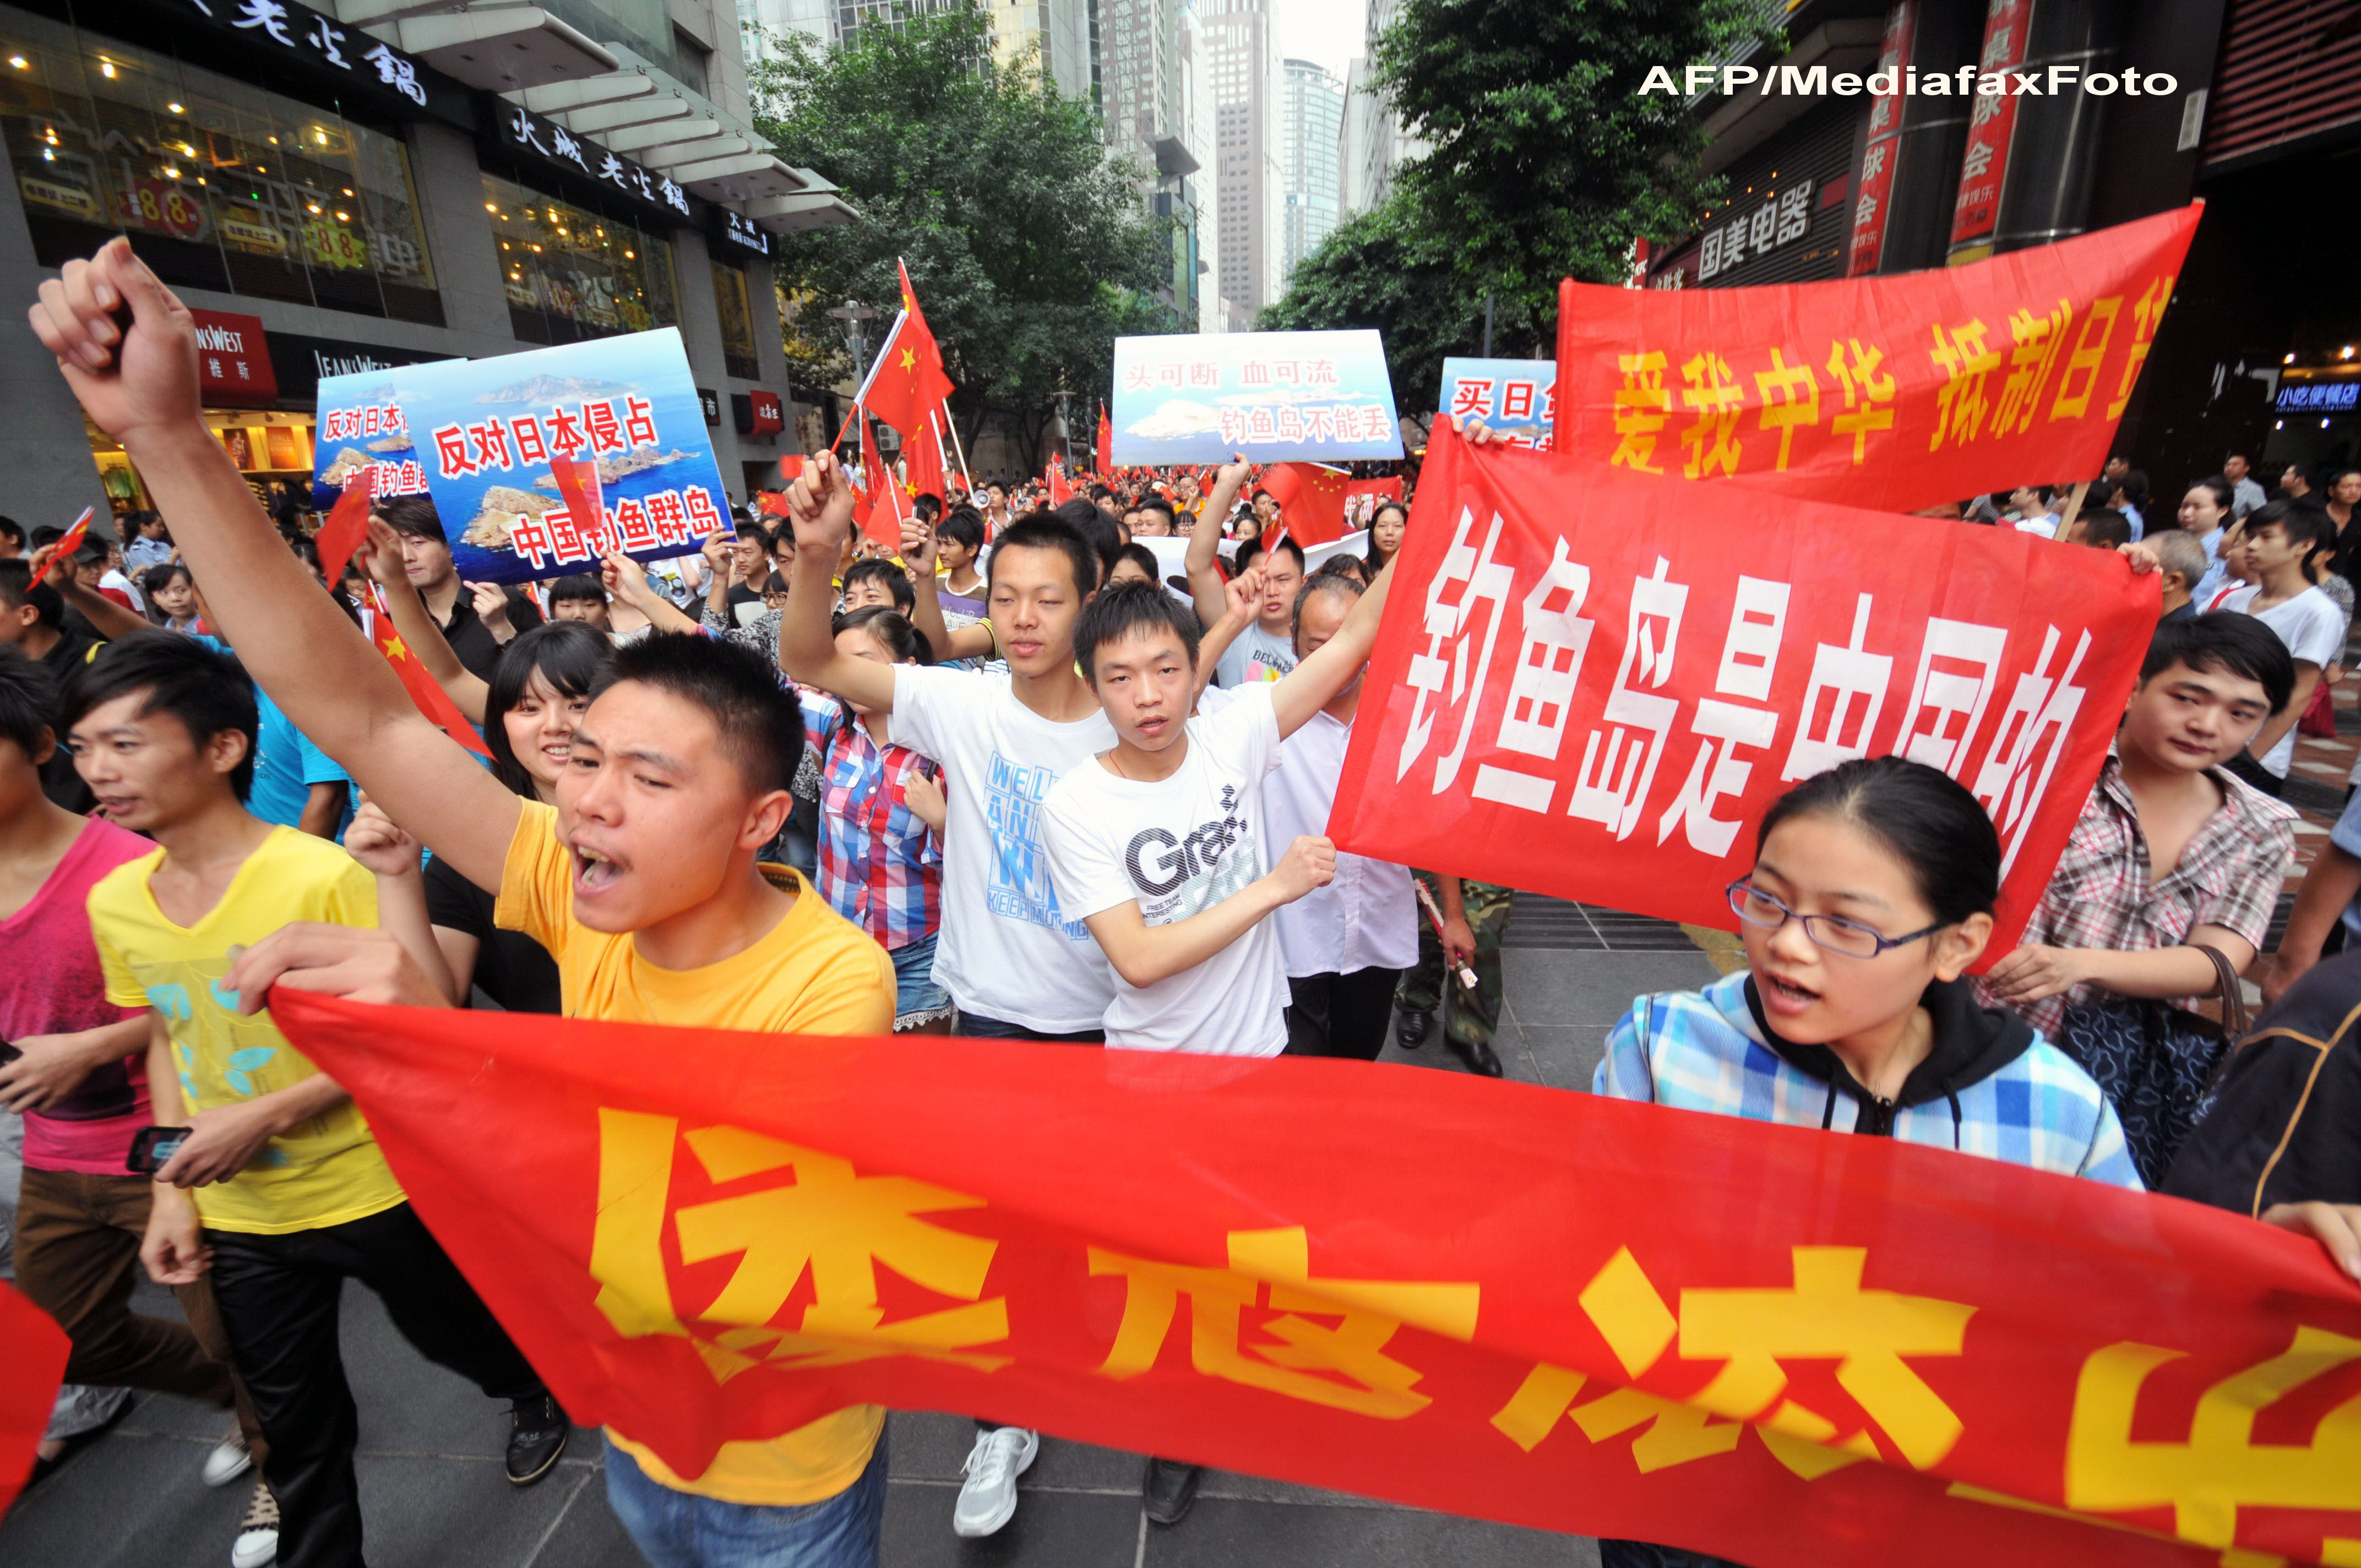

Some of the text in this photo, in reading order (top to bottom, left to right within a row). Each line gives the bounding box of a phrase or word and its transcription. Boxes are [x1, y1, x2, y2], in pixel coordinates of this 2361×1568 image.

[1698, 178, 1812, 281] 国美电器
[1124, 359, 1338, 389] 头可断 血可流
[433, 393, 659, 478] 反对日本侵占
[1219, 406, 1390, 443] 钓鱼岛不能丢
[1610, 337, 1896, 481] 爱我中华
[1396, 504, 2093, 881] 钓鱼岛是中国的
[1142, 899, 1183, 919] NTERESTING
[1146, 892, 1180, 912] FREE TEAM
